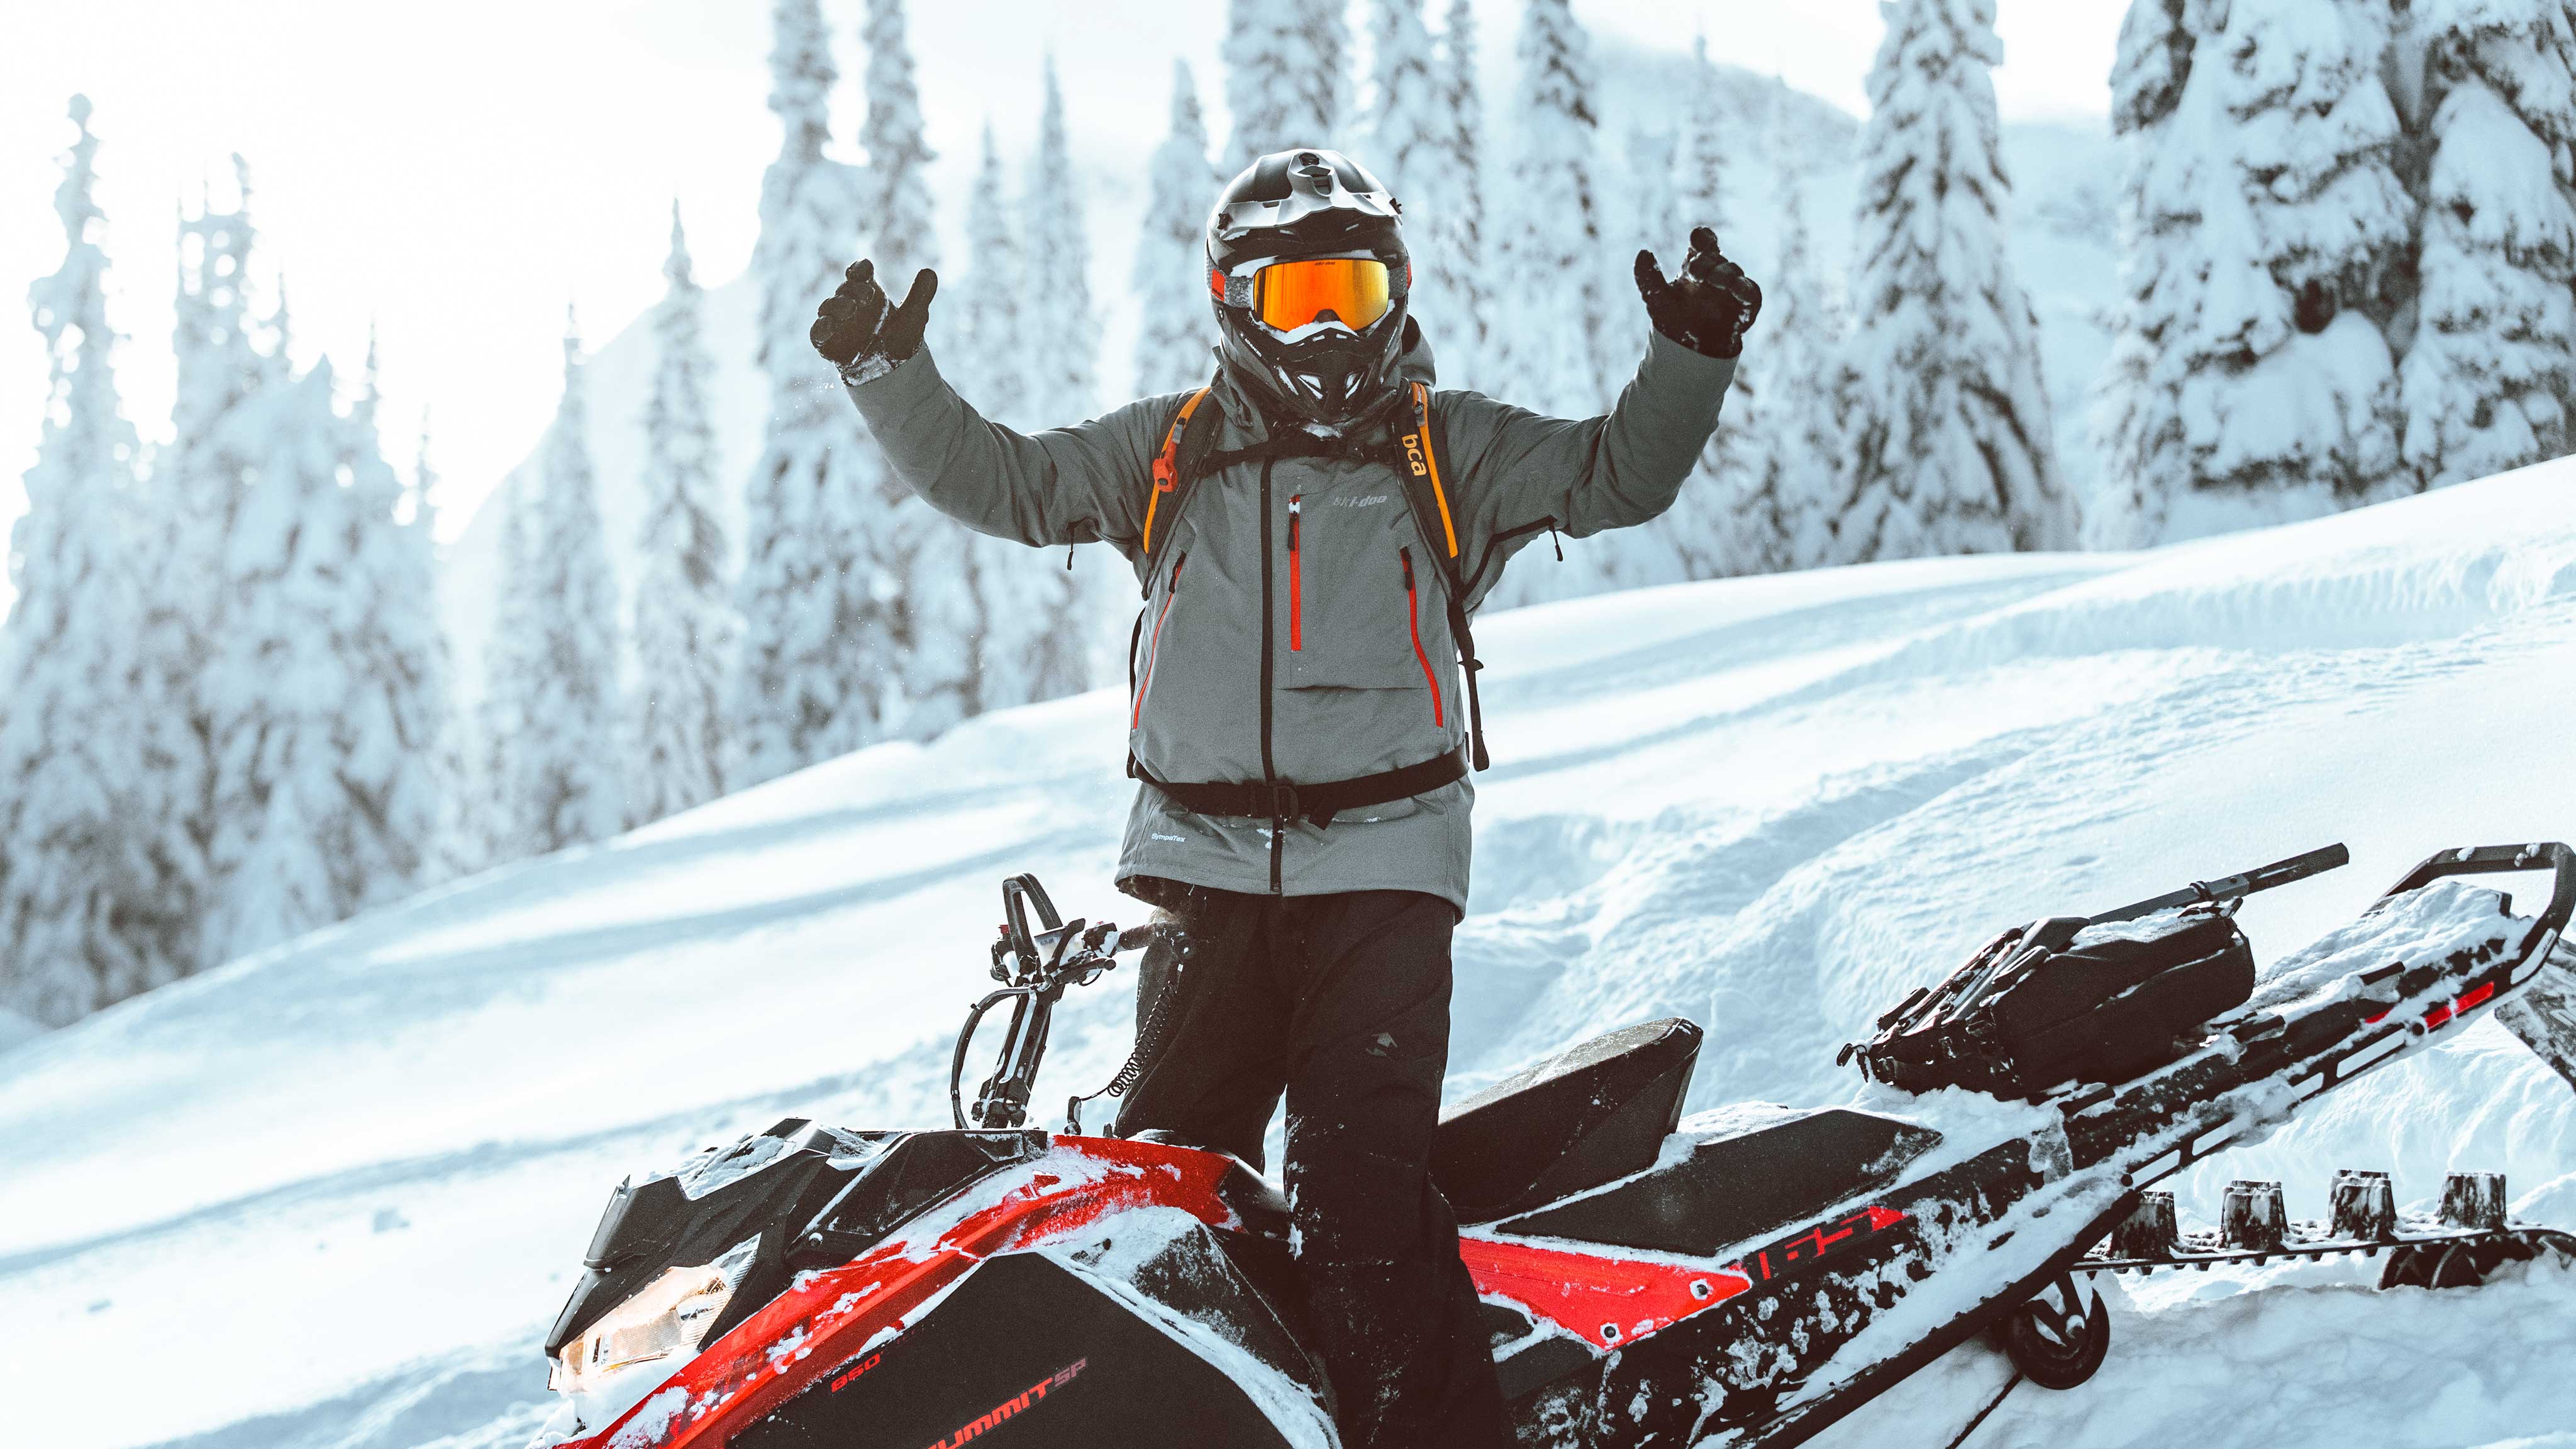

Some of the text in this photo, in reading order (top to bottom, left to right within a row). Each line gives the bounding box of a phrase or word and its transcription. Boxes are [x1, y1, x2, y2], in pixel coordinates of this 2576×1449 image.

[1401, 434, 1426, 476] bca
[831, 1353, 880, 1393] 850
[928, 1357, 1087, 1449] UMMIT SP
